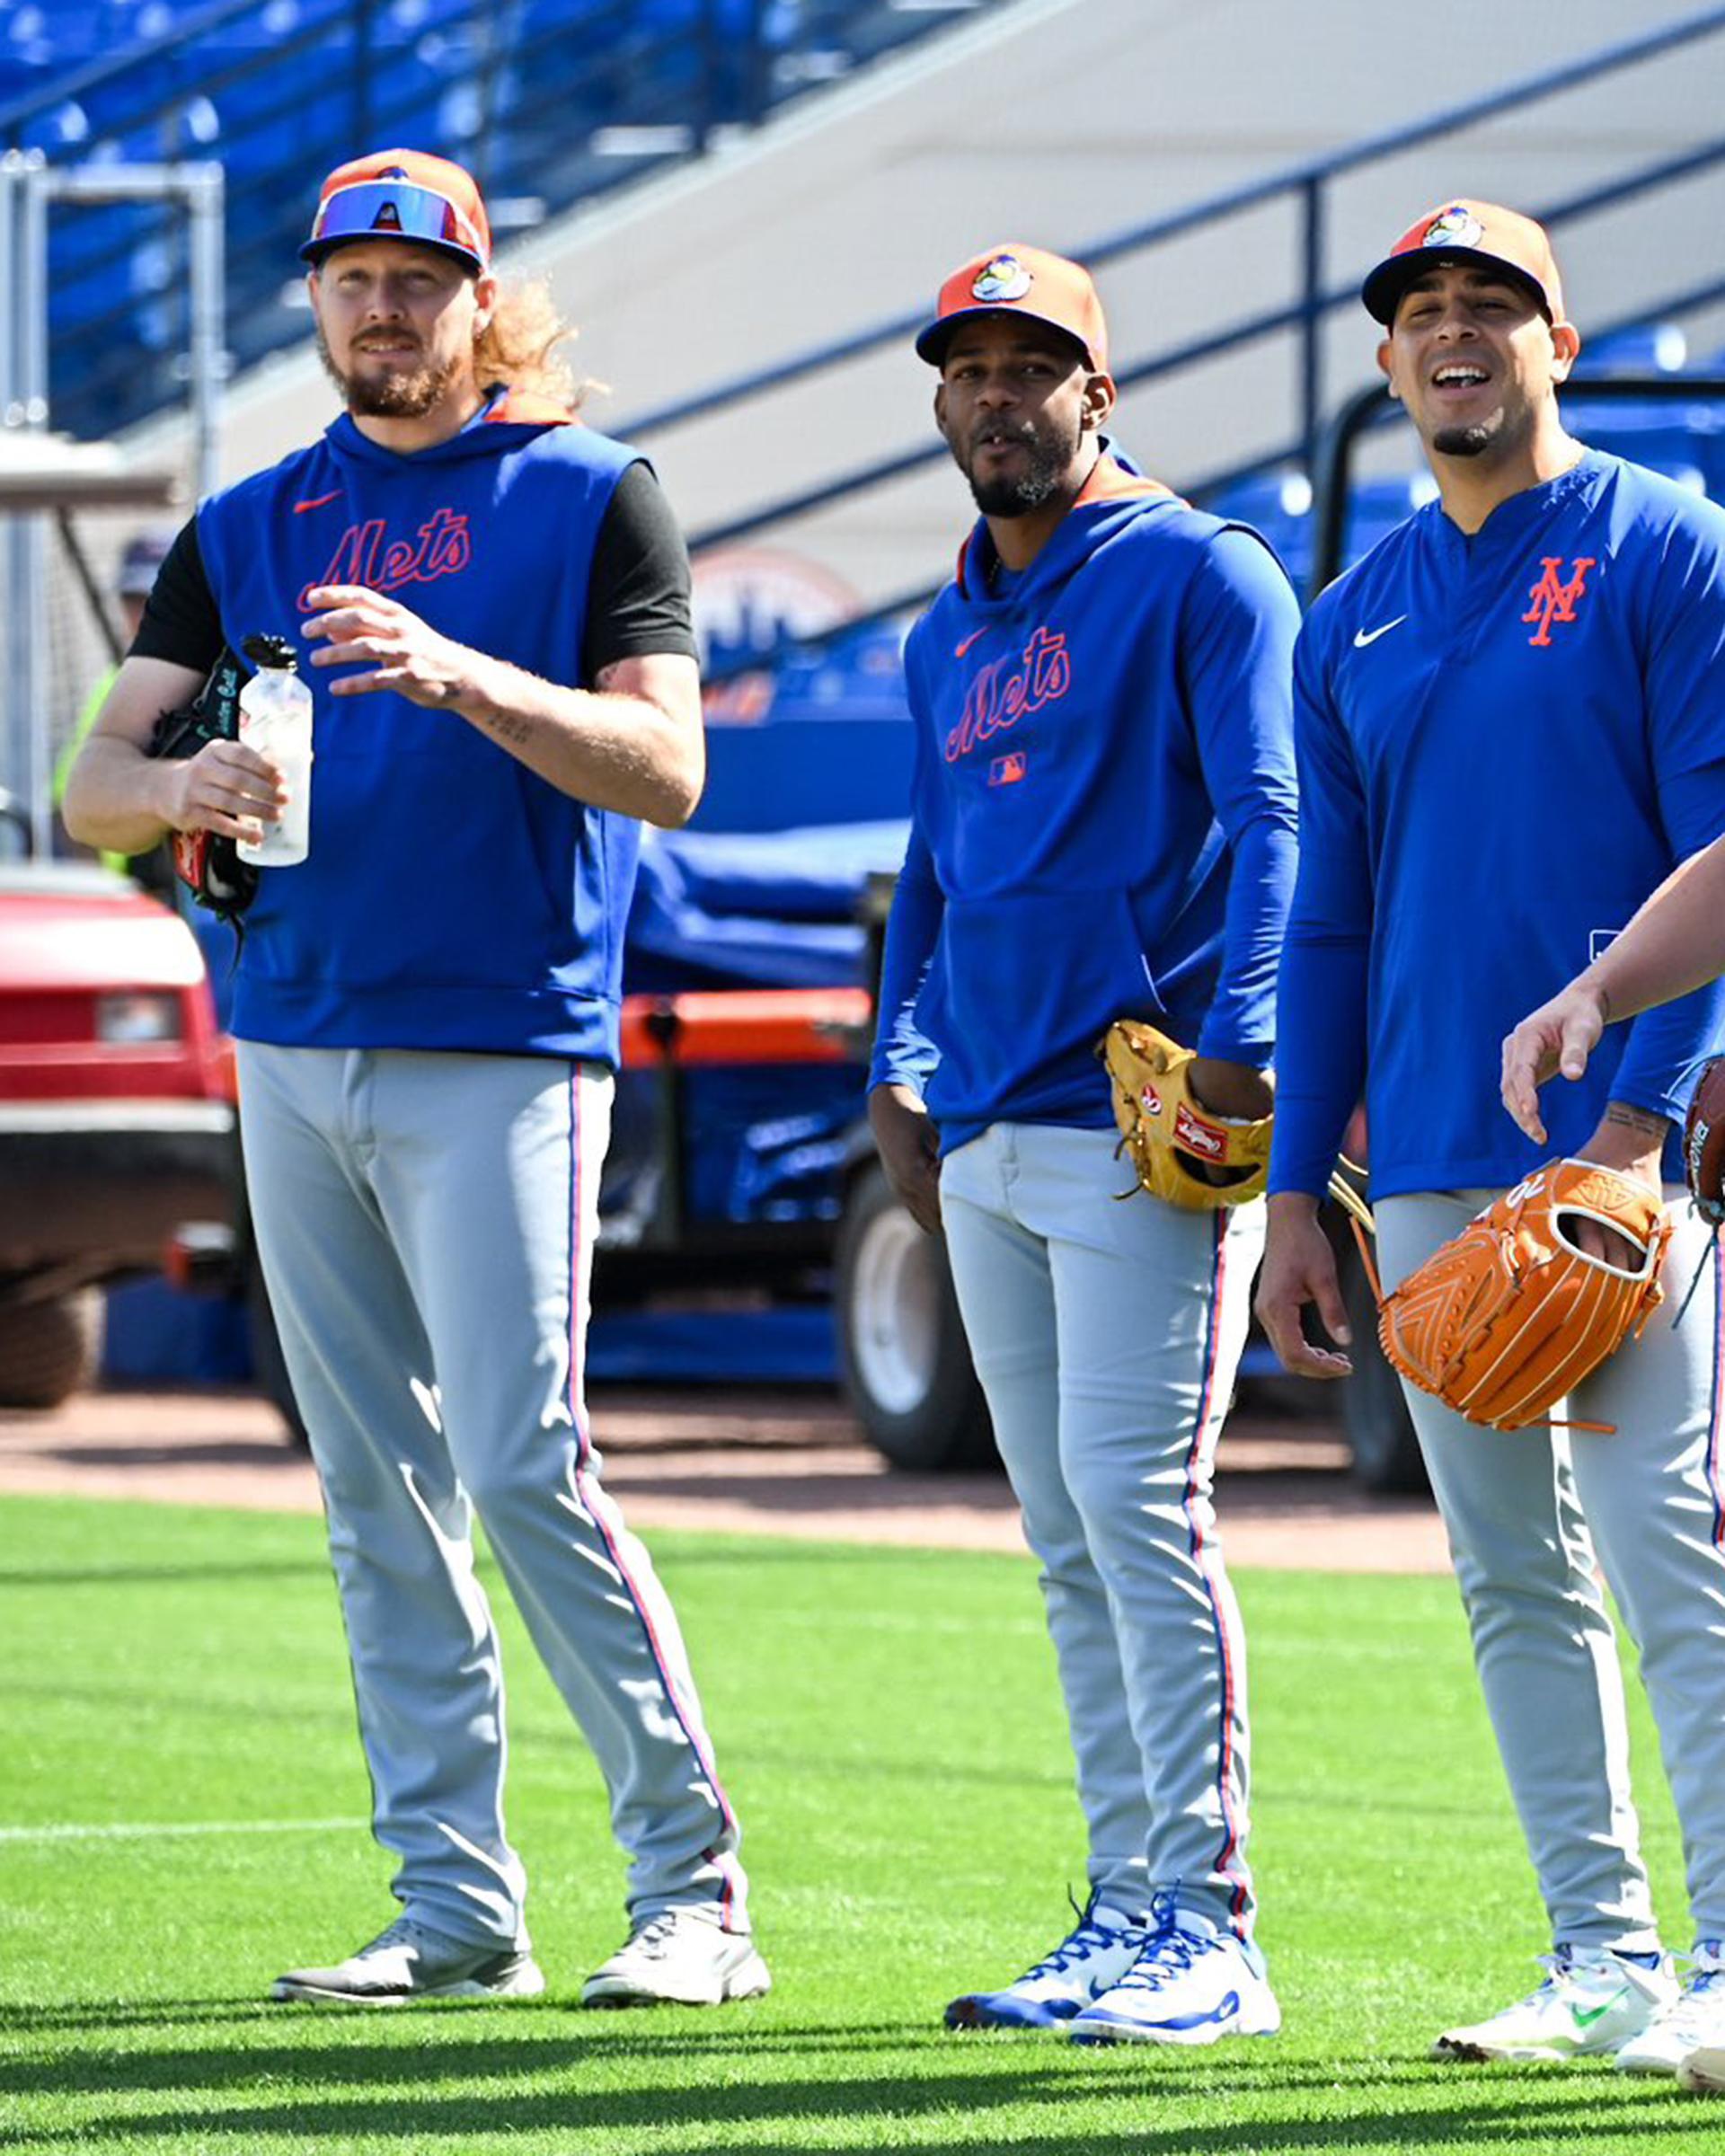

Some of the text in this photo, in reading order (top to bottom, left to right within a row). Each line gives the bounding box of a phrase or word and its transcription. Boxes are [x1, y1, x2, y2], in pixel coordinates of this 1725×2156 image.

[296, 508, 471, 613] Mets
[1521, 556, 1596, 646] NY
[945, 626, 1070, 762] Mets
